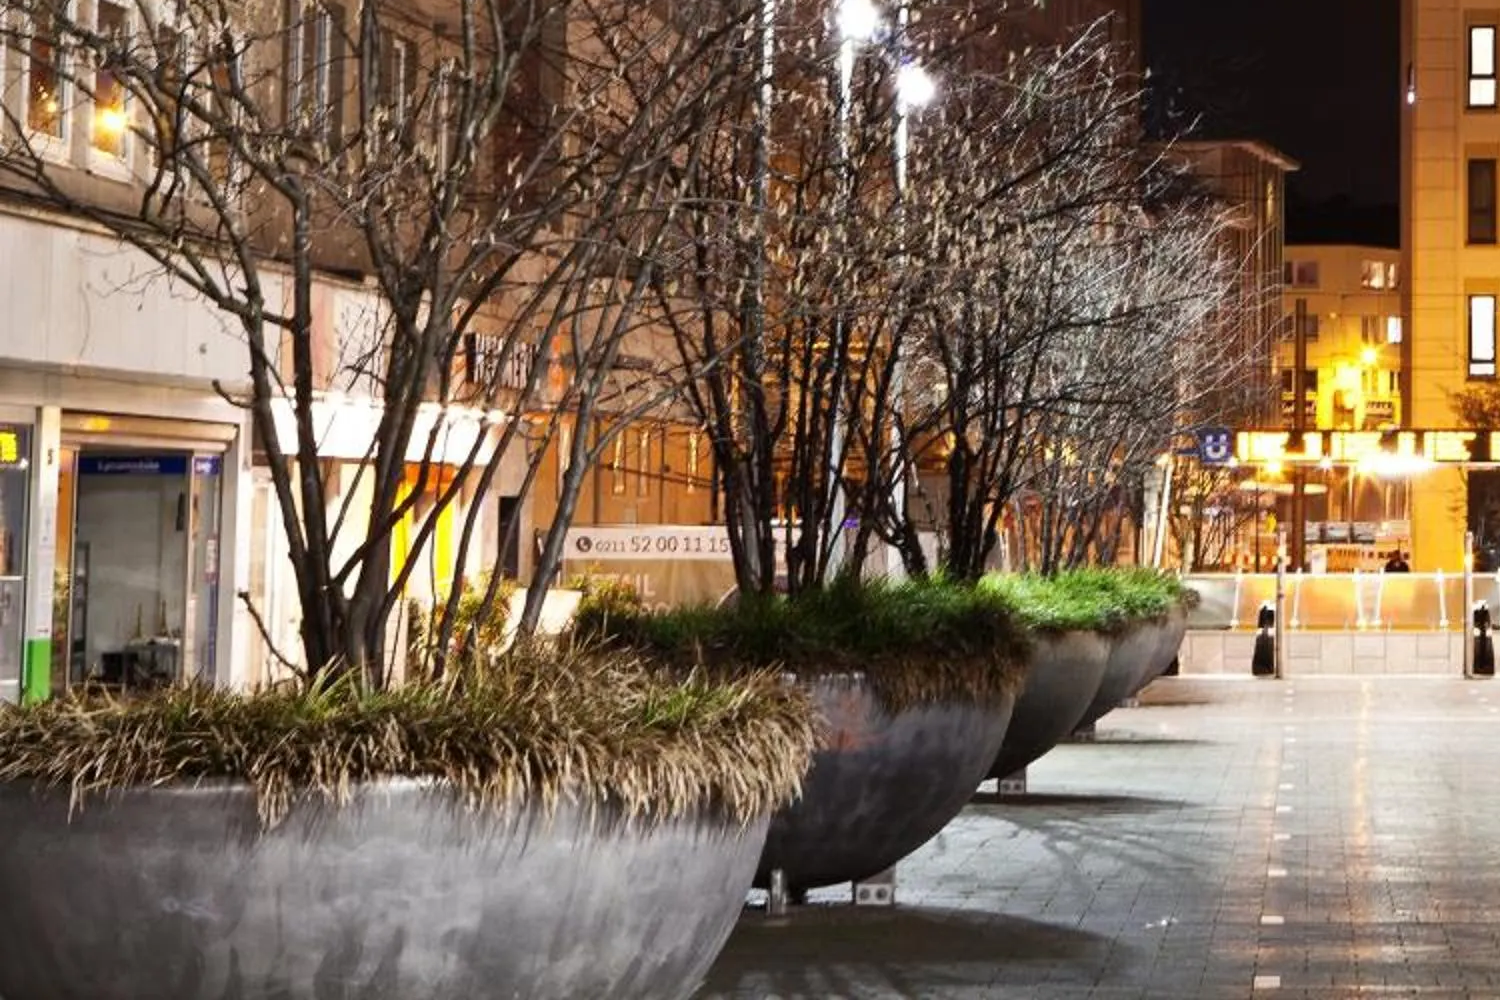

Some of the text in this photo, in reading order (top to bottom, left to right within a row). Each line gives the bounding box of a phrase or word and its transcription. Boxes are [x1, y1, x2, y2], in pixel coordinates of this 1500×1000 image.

[595, 540, 626, 553] 0211
[631, 536, 652, 553] 52
[656, 536, 679, 553] 00
[683, 536, 702, 553] 11
